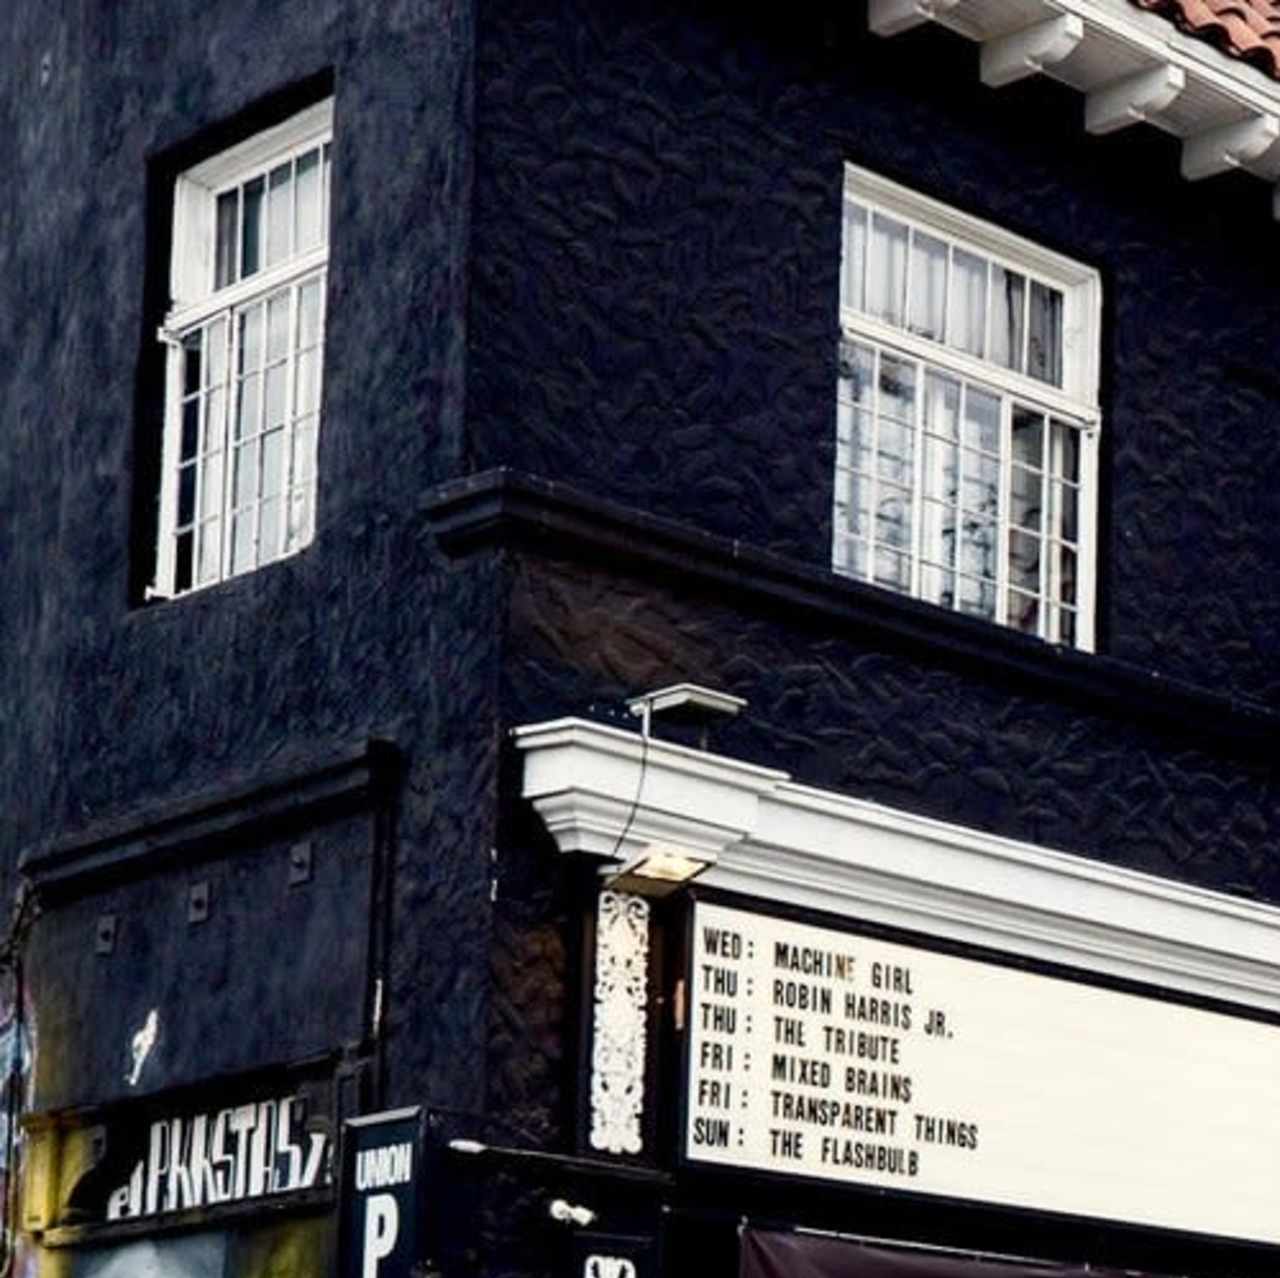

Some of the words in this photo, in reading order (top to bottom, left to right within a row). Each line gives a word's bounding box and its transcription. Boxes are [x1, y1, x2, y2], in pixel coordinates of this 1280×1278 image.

[774, 942, 856, 981] MACHINE
[872, 962, 914, 995] GIRL
[773, 979, 832, 1014] ROBIN
[845, 993, 913, 1030] HARRIS
[925, 1009, 954, 1038] JR.
[773, 1016, 806, 1047] THE
[822, 1026, 901, 1065] TRIBUTE
[771, 1054, 831, 1088] MIXED
[845, 1067, 913, 1104] BRAINS
[770, 1091, 898, 1136] TRANSPARENT
[914, 1115, 979, 1150] THINGS
[355, 1143, 413, 1192] UNION
[769, 1129, 803, 1159] THE
[820, 1138, 920, 1177] FLASHBULB
